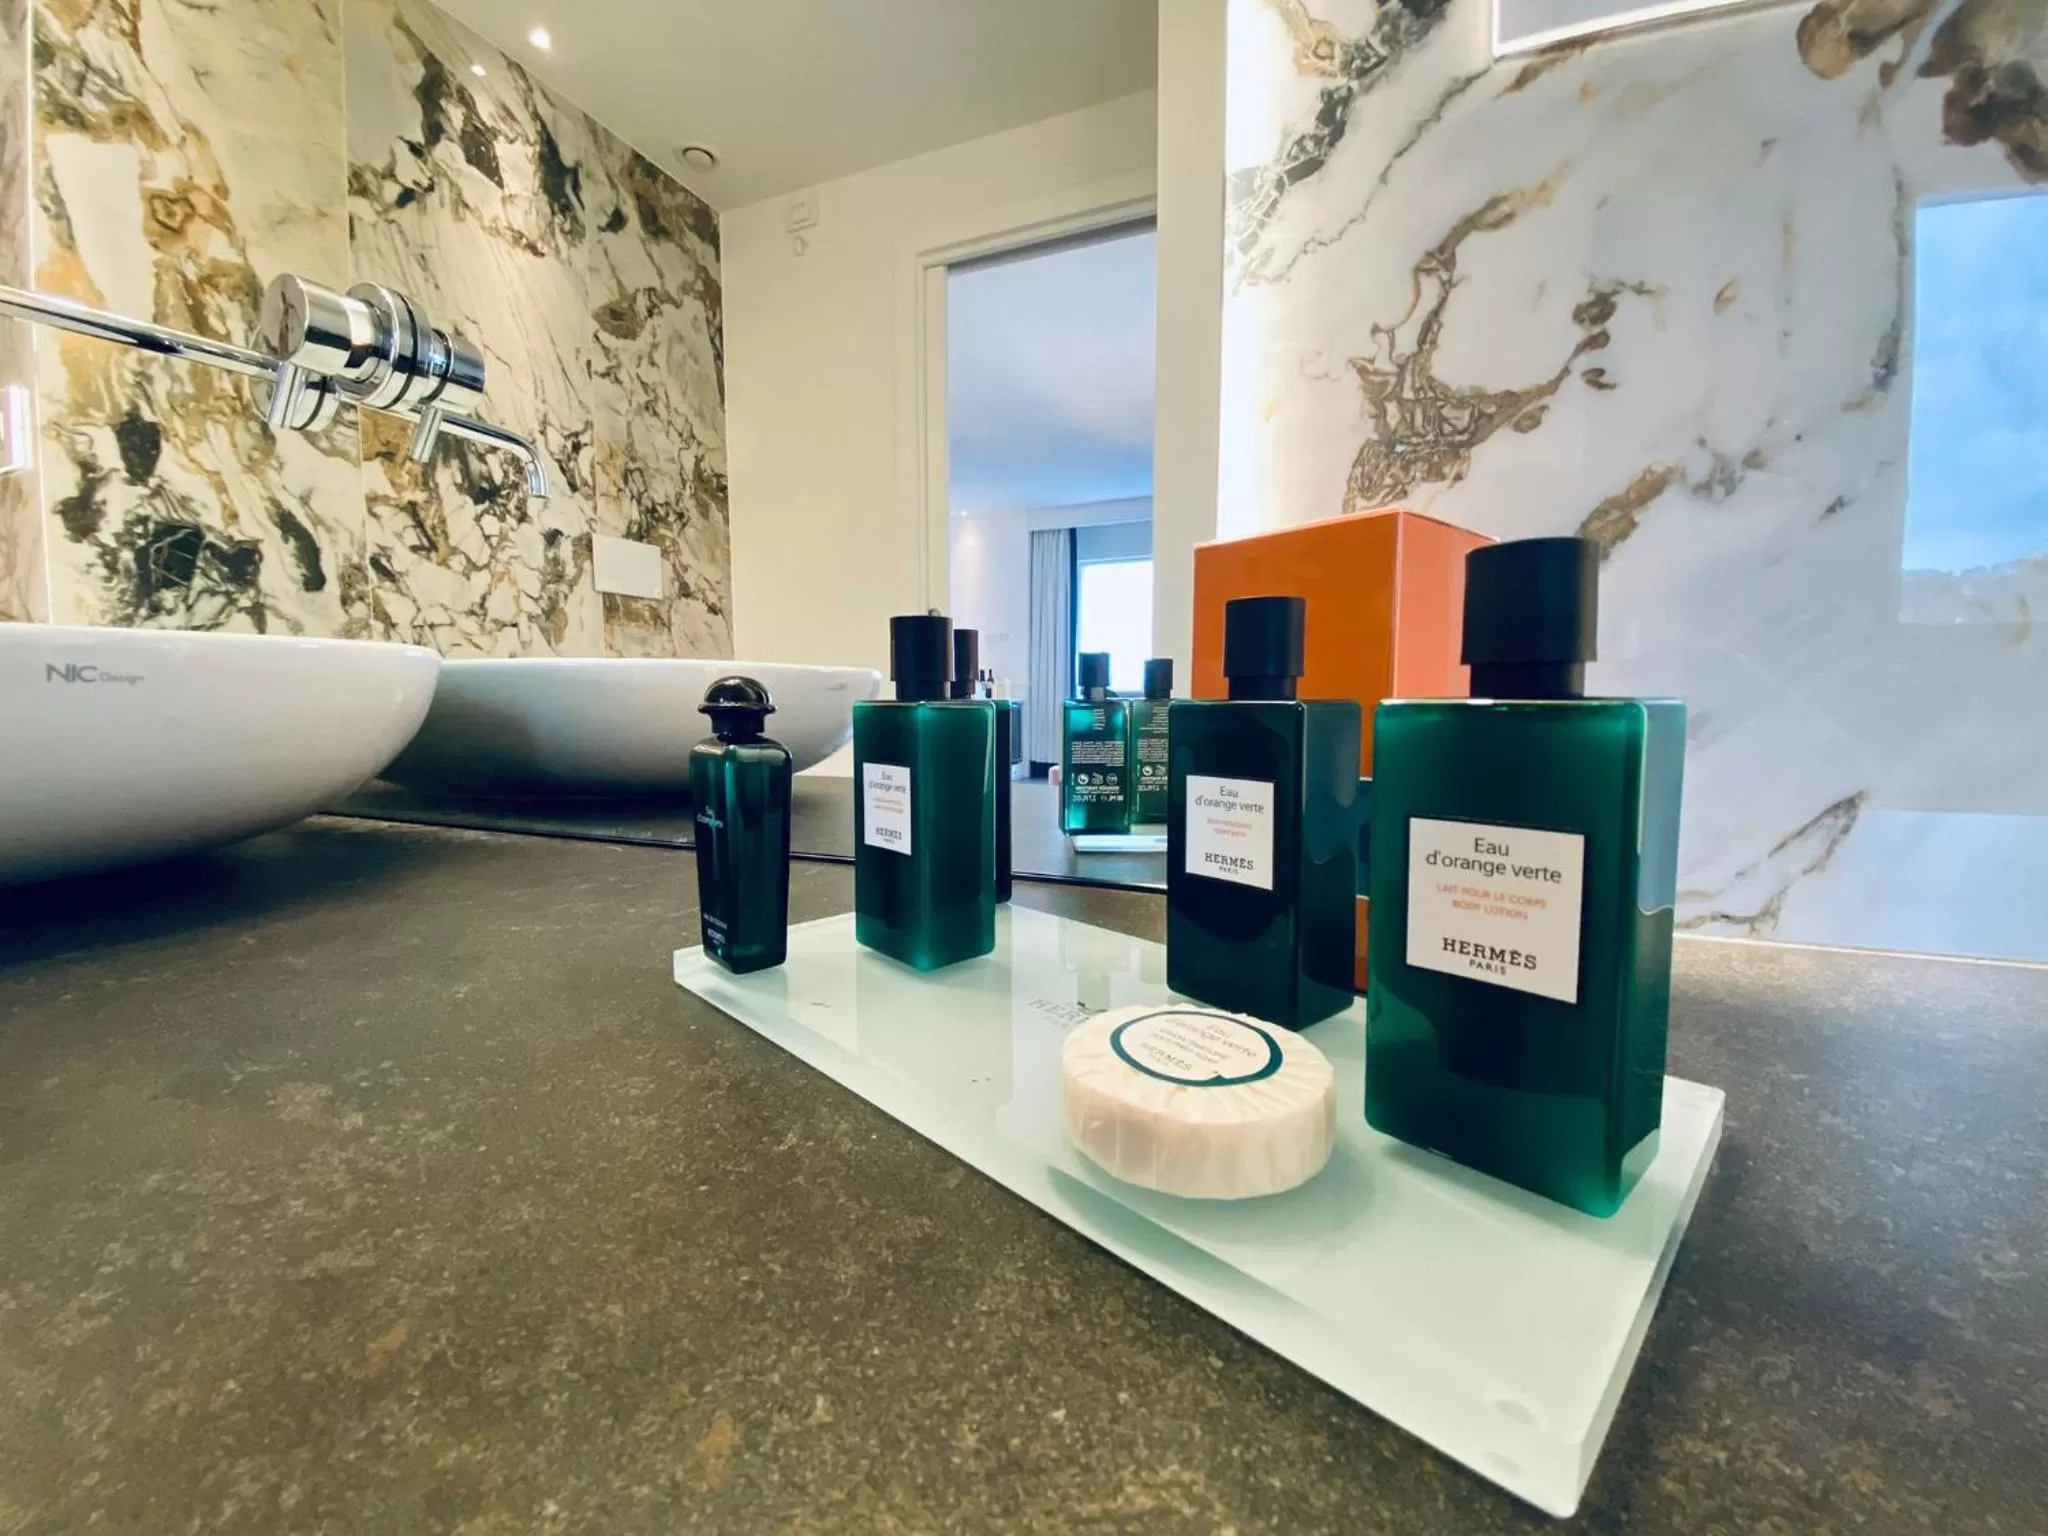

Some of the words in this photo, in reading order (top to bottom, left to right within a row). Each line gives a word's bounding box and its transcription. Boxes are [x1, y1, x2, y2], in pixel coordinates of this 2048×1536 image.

[46, 663, 99, 684] NIC
[1220, 786, 1239, 798] Eau
[1240, 802, 1265, 814] verte
[1474, 837, 1510, 857] Eau
[1425, 850, 1507, 877] d'orange
[1511, 863, 1562, 884] verte
[1468, 959, 1507, 976] PARIS
